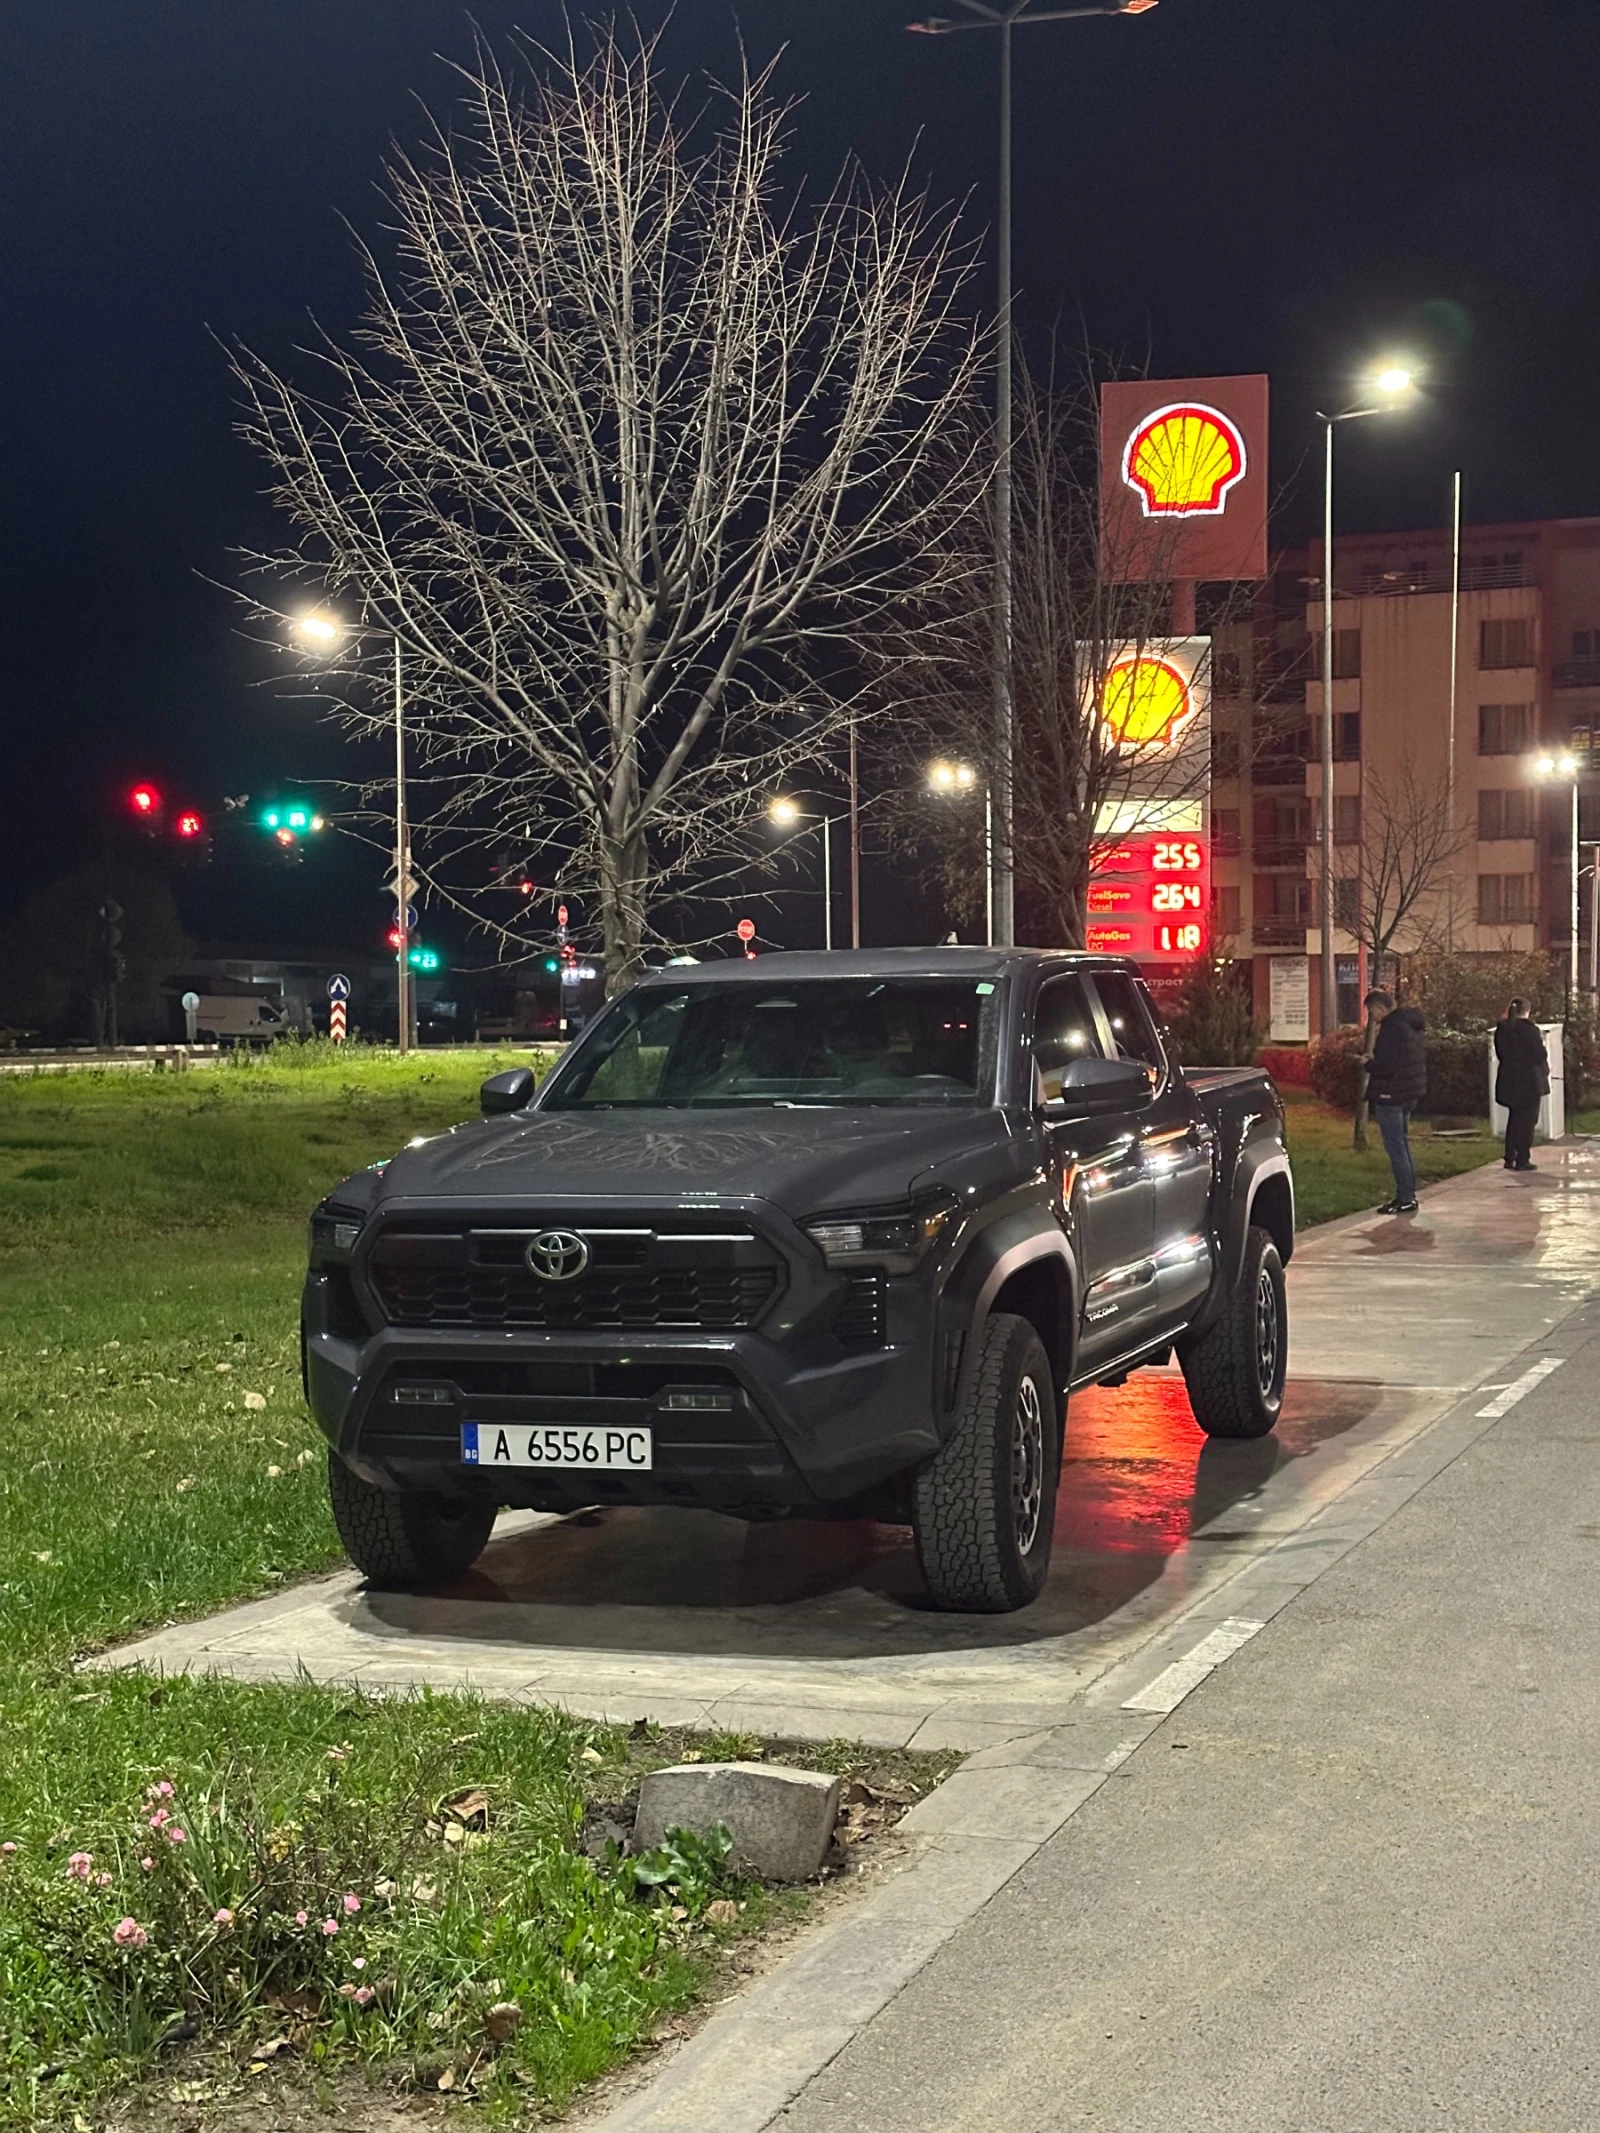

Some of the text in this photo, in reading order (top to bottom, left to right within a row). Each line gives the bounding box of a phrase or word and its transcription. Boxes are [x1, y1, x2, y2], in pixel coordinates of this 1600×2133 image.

[1087, 890, 1131, 900] FuelSave
[1087, 901, 1113, 911] Diesel
[1087, 930, 1131, 940] AutoGas
[1087, 941, 1103, 951] LPG
[1087, 1303, 1119, 1322] TACOMA
[493, 1429, 646, 1464] A 6556 PC
[465, 1449, 478, 1459] BG
